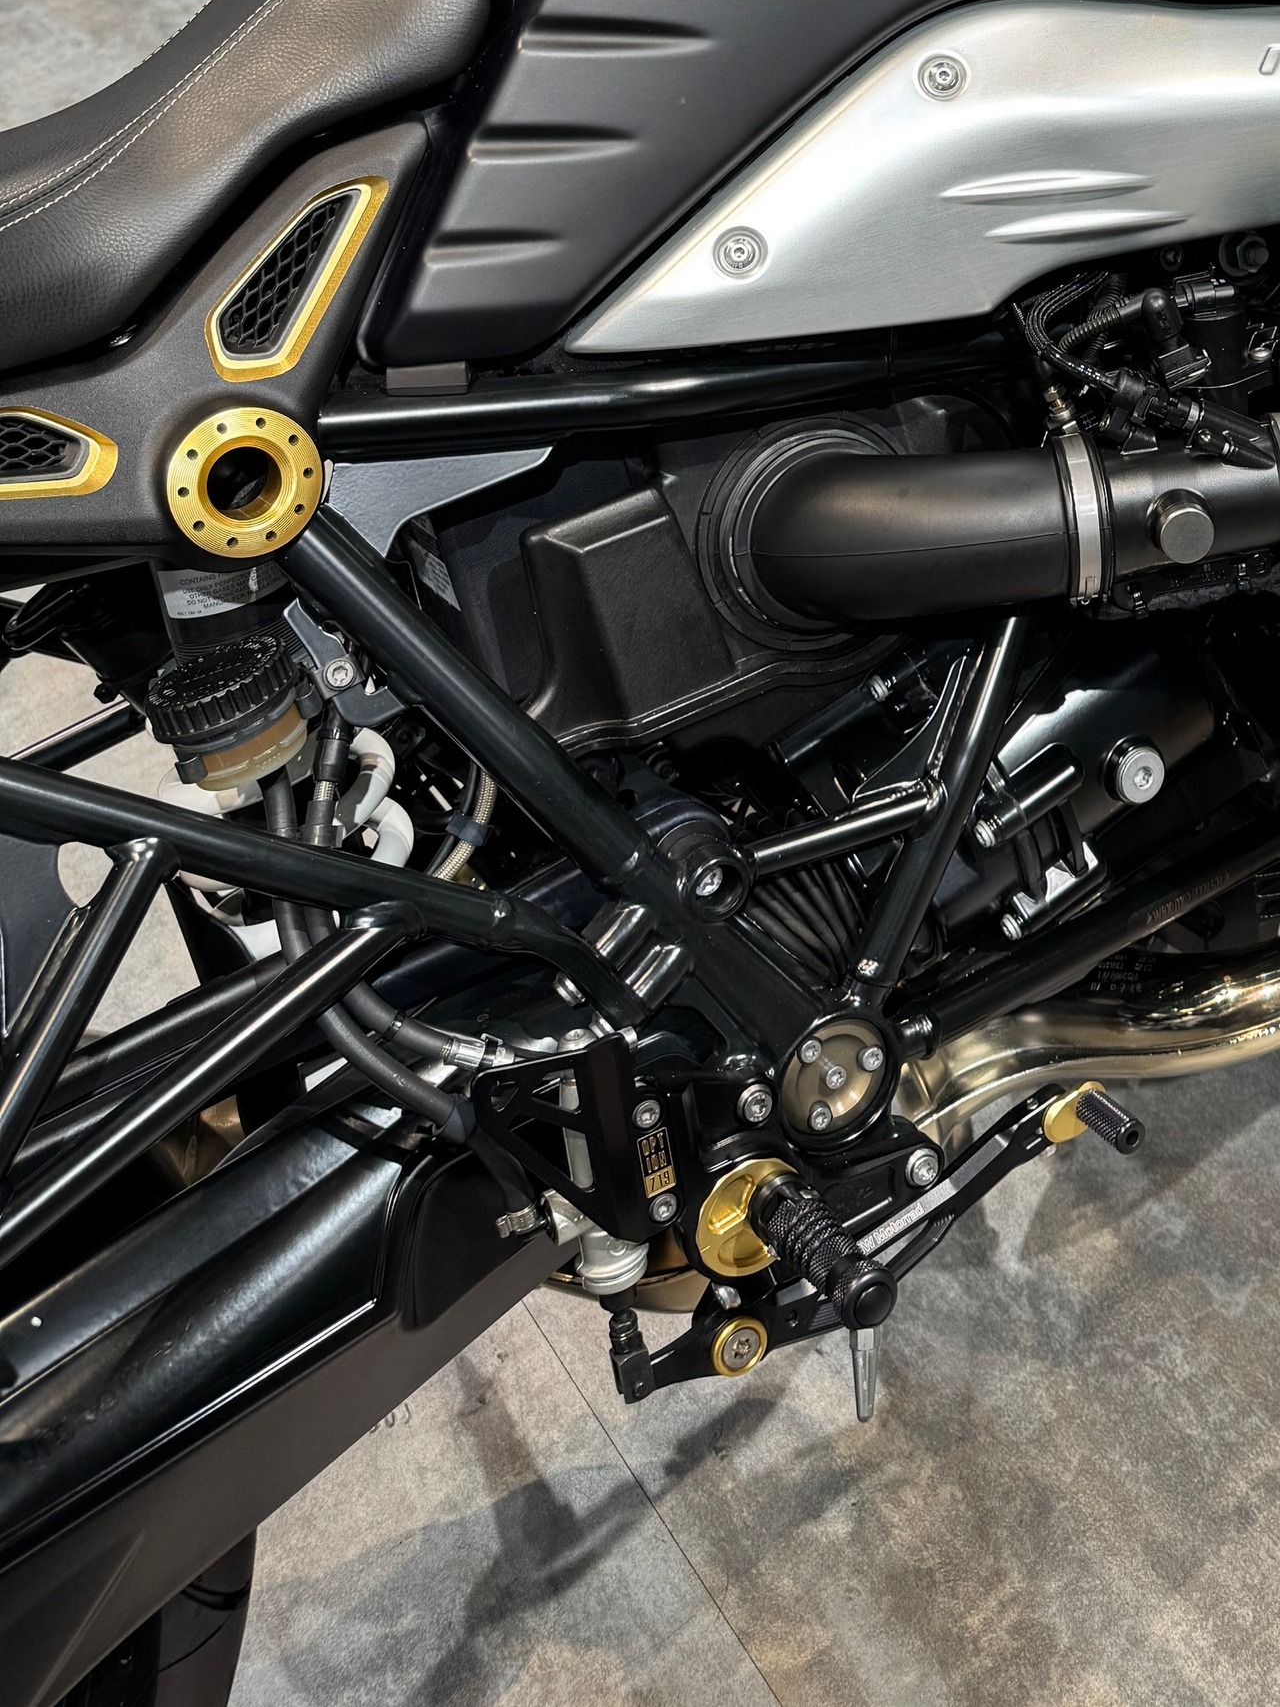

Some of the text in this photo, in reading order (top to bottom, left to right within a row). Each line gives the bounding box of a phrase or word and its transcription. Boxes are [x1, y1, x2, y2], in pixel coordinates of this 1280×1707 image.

[180, 573, 217, 586] CONTAINS
[642, 1131, 664, 1156] OPT
[645, 1150, 667, 1174] ION
[649, 1170, 670, 1192] 719
[876, 1201, 925, 1241] Motorrad
